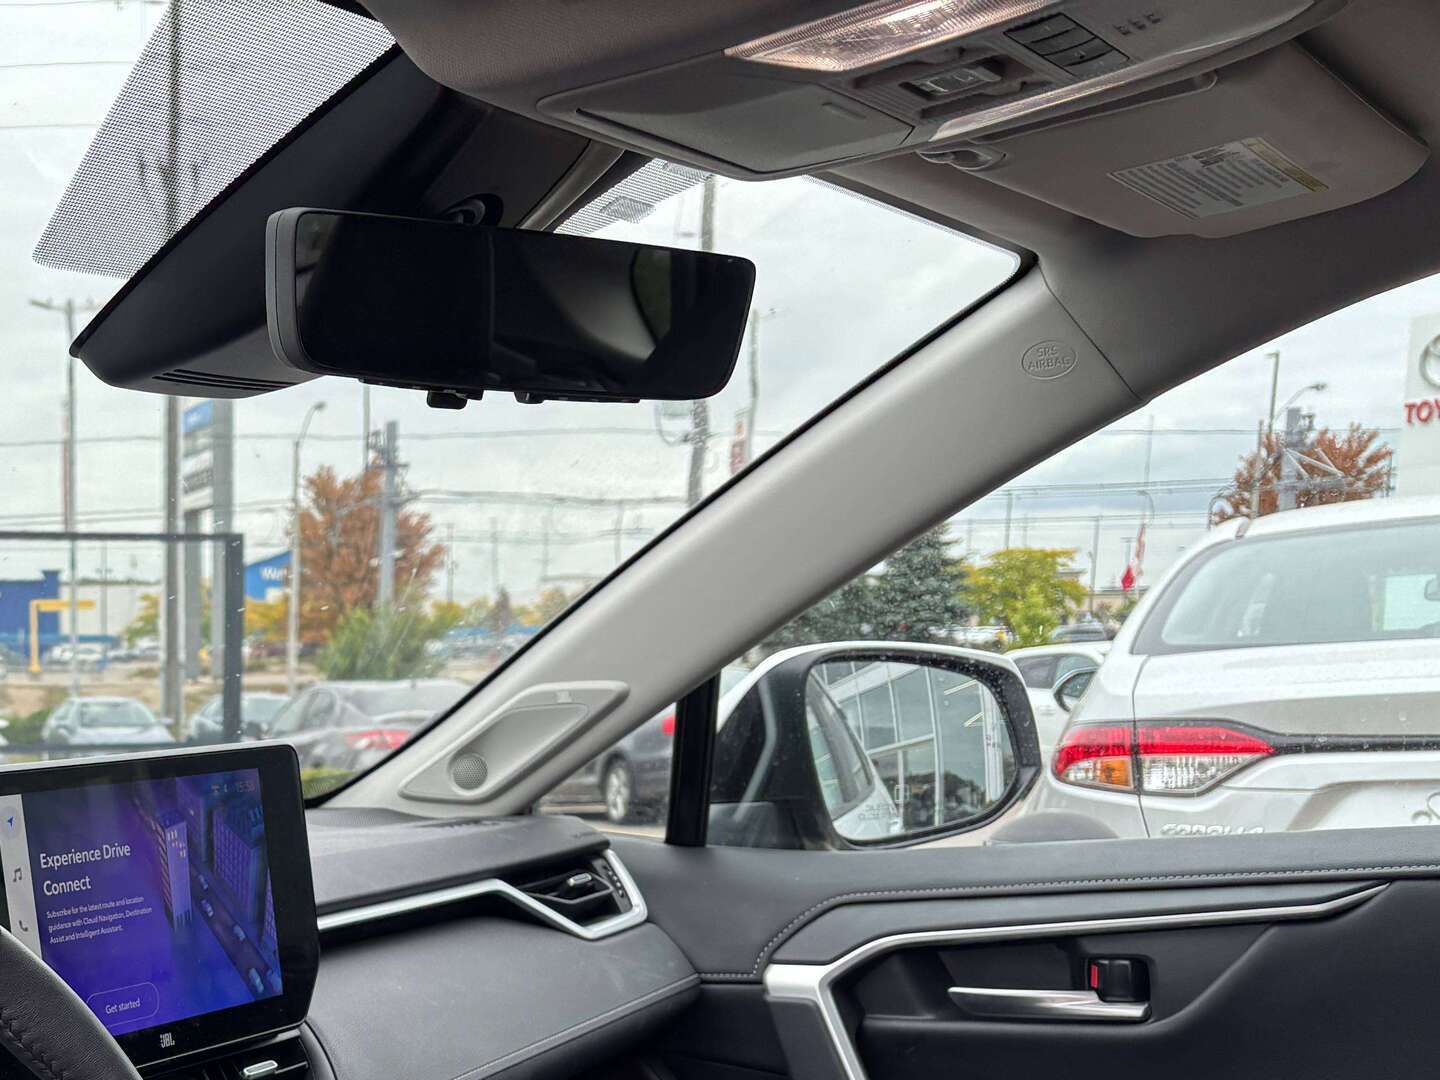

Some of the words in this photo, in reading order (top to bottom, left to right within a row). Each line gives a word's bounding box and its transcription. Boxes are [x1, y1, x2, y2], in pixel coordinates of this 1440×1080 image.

[1028, 357, 1071, 370] AIRBAG
[40, 849, 101, 870] Experience
[103, 842, 131, 859] Drive
[43, 876, 91, 896] Connect
[105, 1004, 118, 1014] Get
[118, 997, 141, 1011] started
